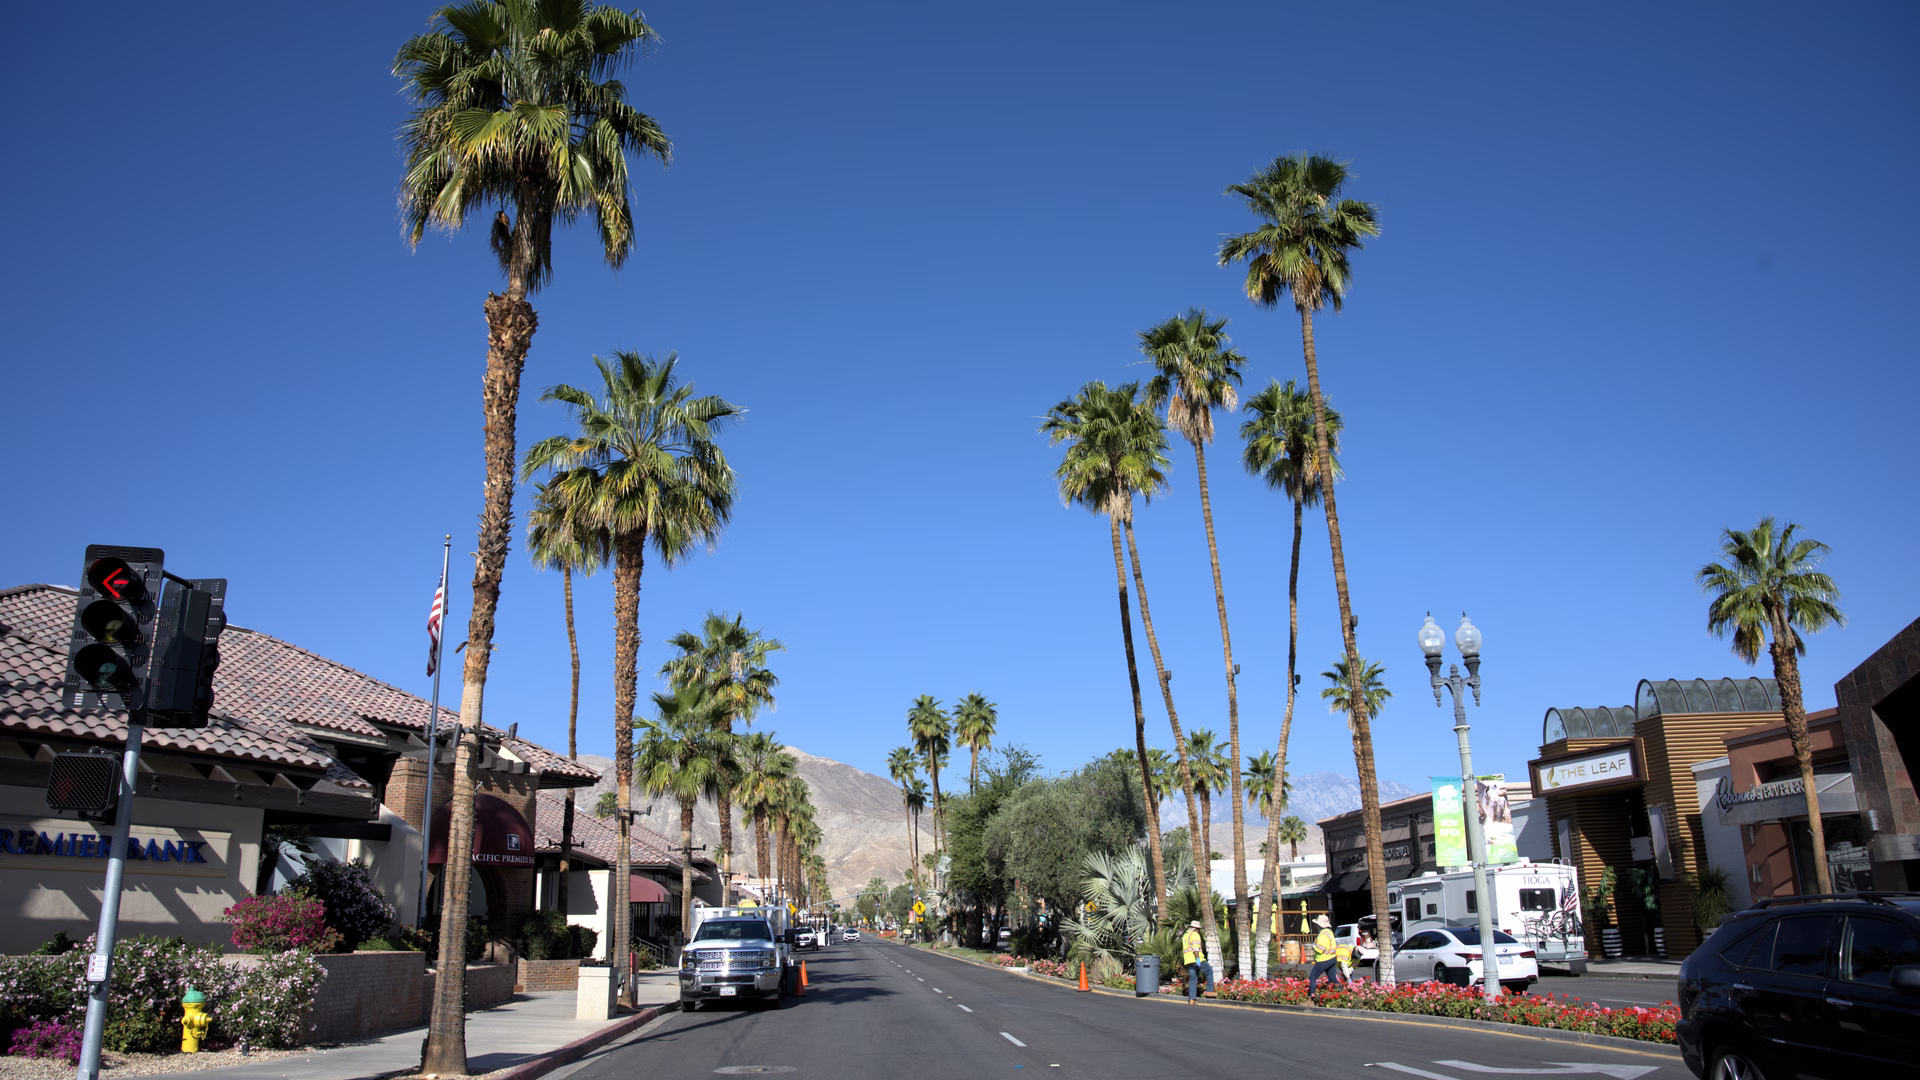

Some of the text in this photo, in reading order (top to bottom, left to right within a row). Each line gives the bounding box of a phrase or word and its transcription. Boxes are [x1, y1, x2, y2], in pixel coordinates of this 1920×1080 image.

[1559, 759, 1626, 779] THE LEAF
[1758, 780, 1805, 801] JEWELER
[0, 829, 208, 863] REMIER BANK
[472, 853, 500, 862] ACIFIC
[502, 854, 528, 864] PREMIER
[1522, 876, 1550, 885] TIOGA
